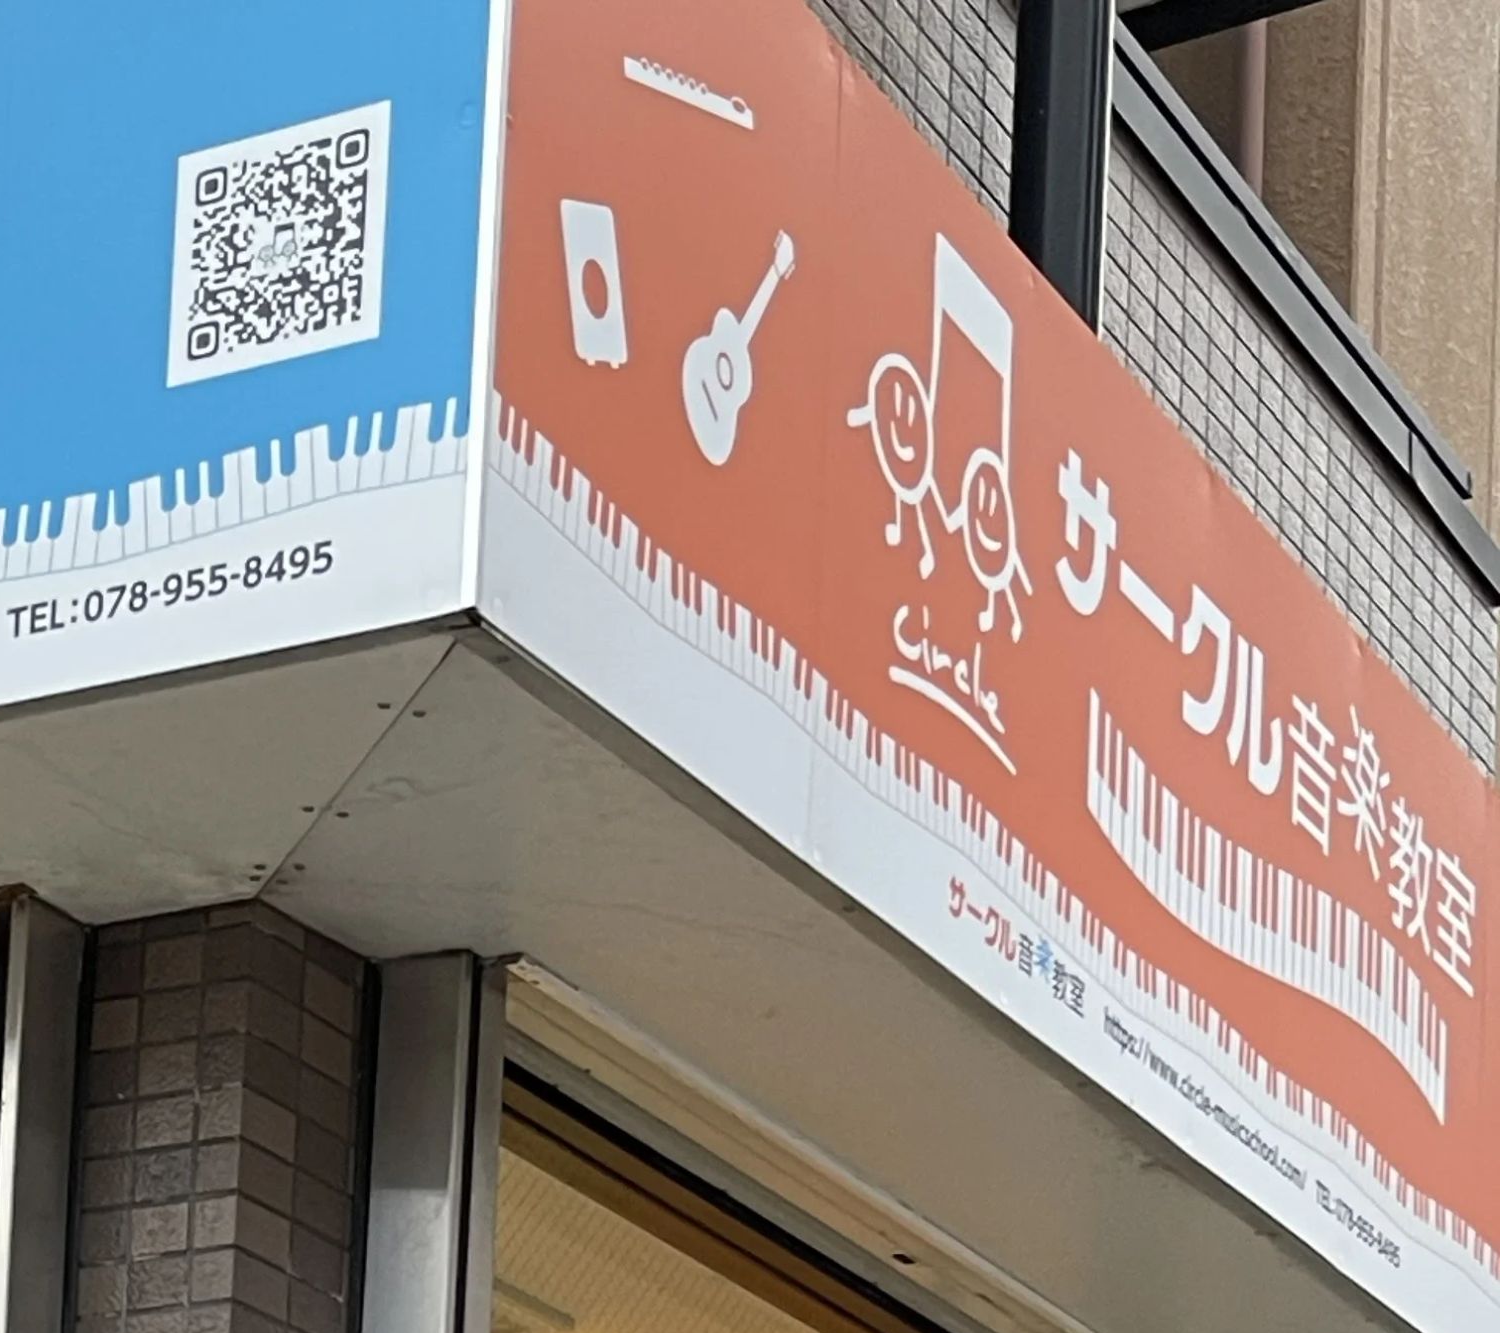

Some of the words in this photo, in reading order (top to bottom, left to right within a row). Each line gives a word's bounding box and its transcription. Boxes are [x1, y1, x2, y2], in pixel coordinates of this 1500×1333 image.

[1055, 447, 1477, 998] サークル音楽教室
[948, 874, 1086, 1018] サークル音楽教室
